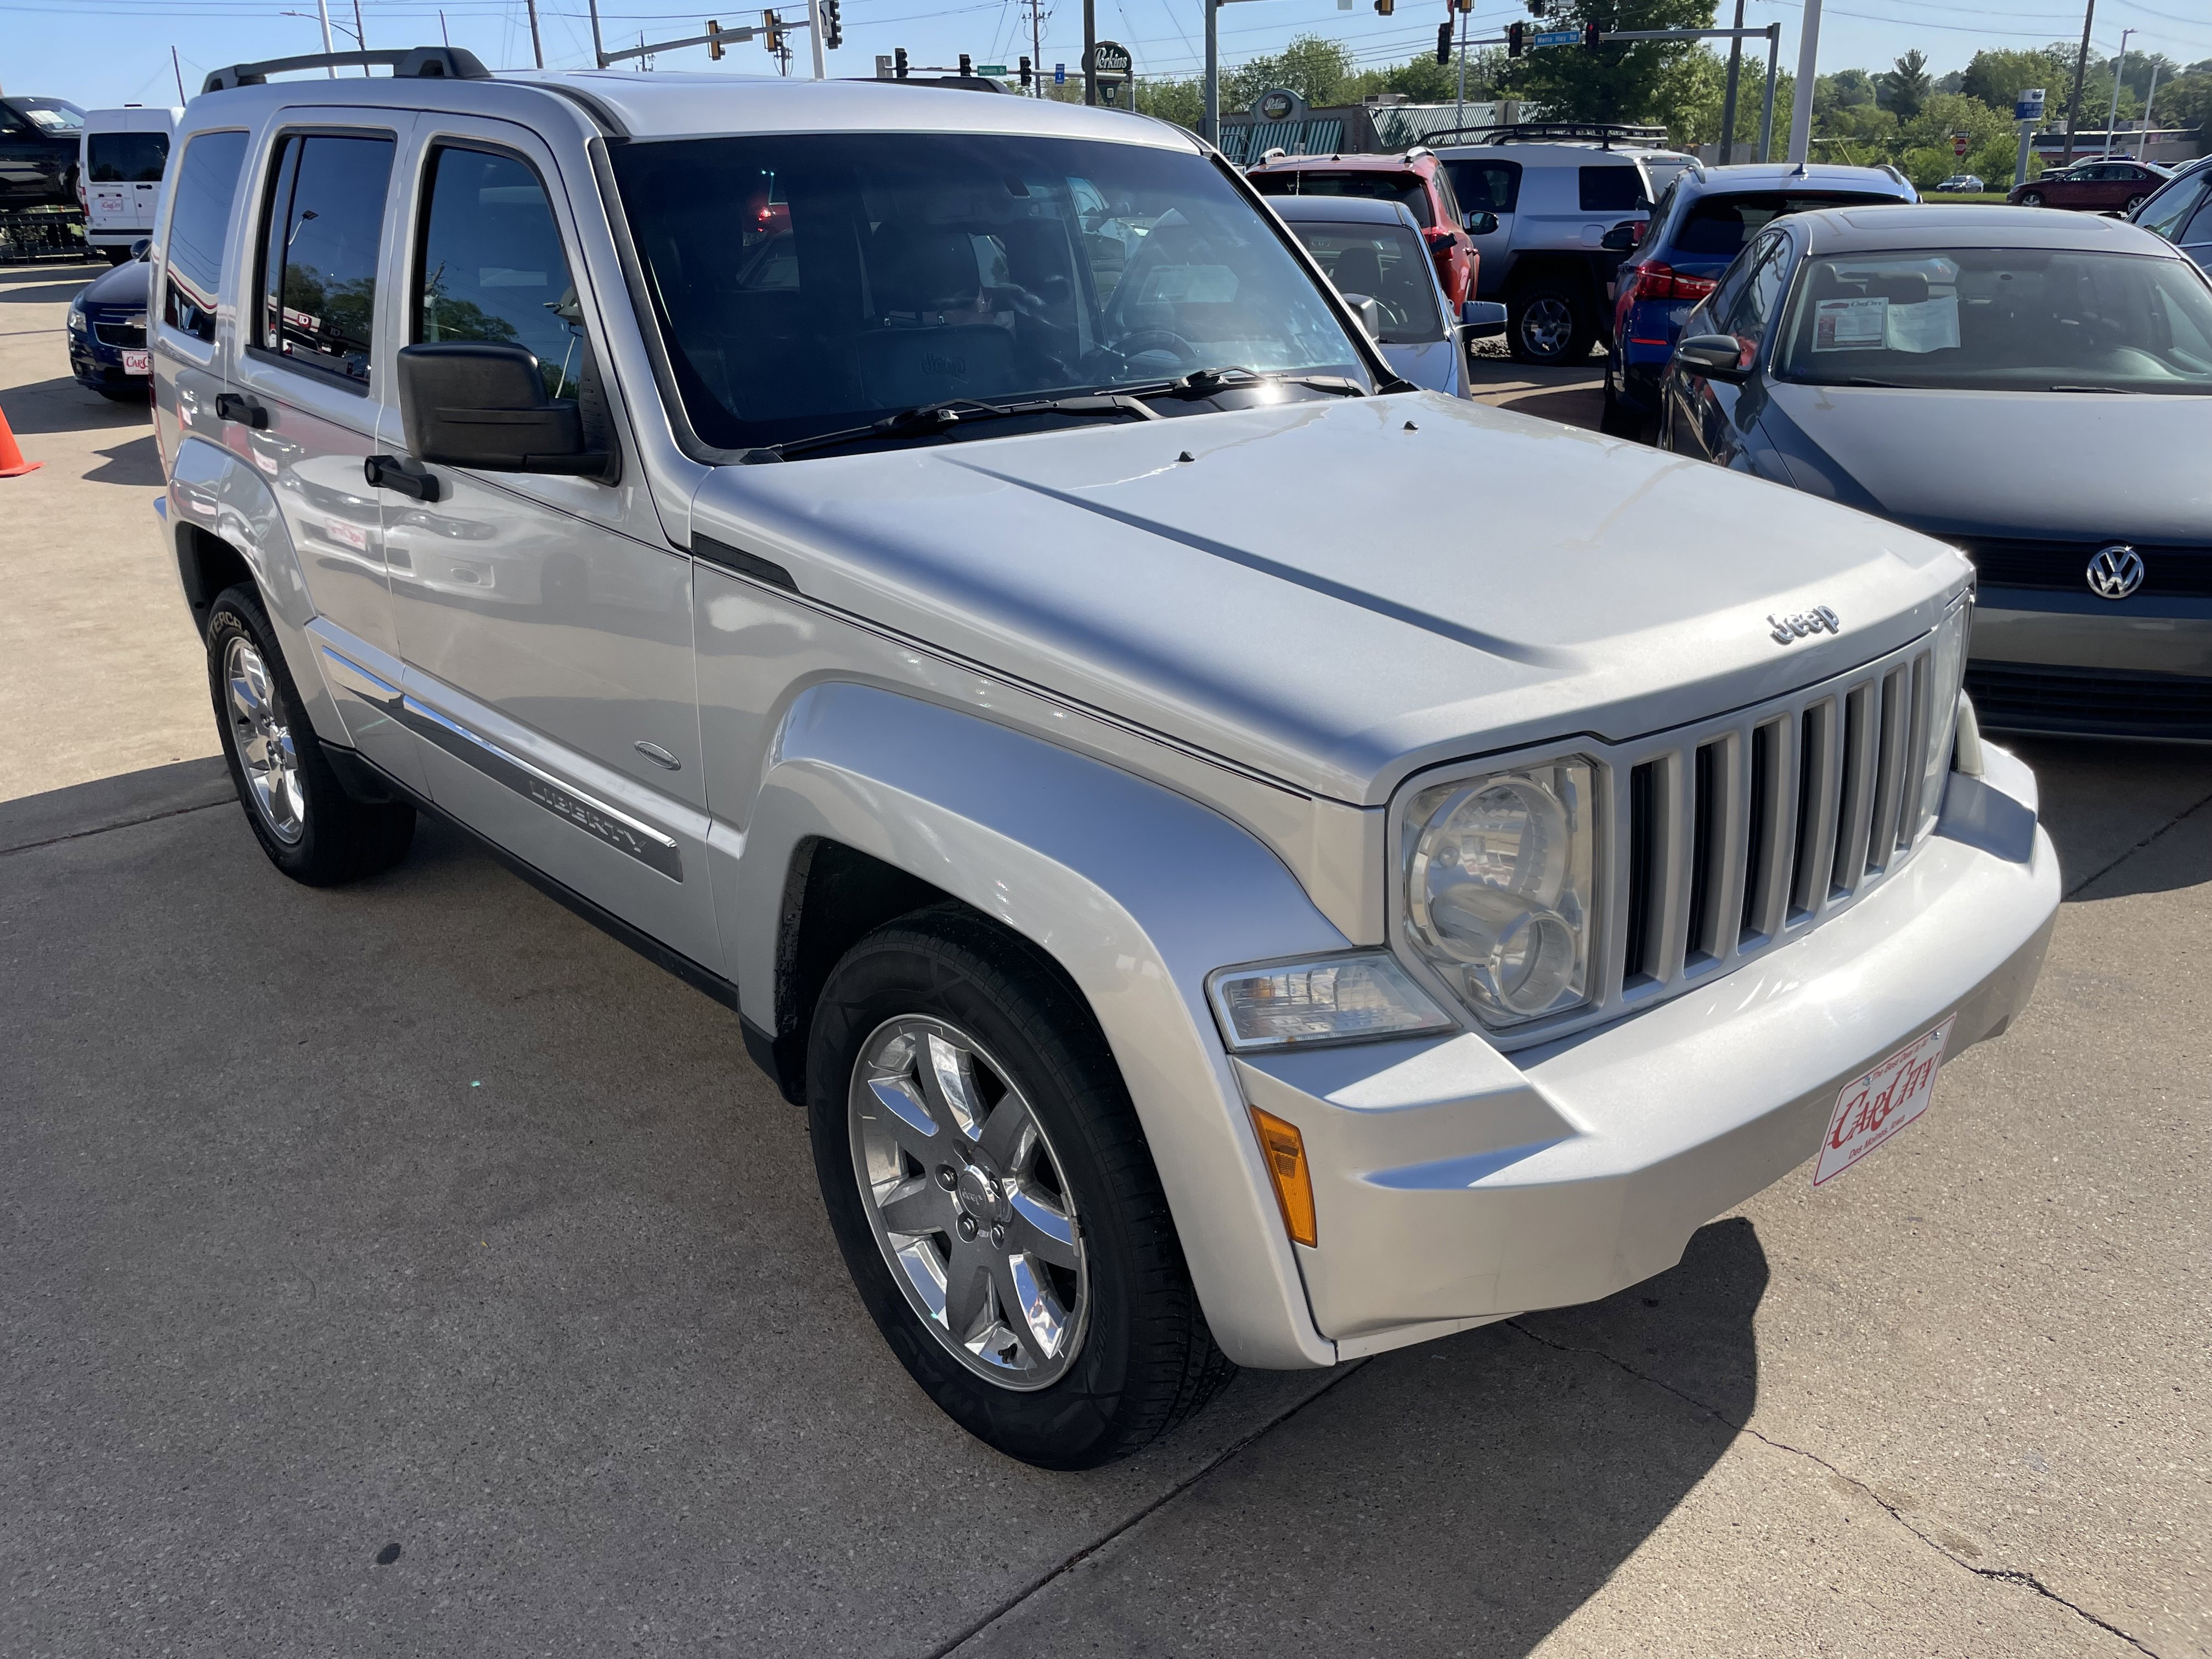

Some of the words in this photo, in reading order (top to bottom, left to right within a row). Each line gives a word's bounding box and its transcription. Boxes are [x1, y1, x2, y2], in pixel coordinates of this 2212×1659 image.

[1095, 47, 1127, 69] Perkins
[920, 352, 964, 375] Jeep
[1767, 606, 1839, 646] Jeep
[529, 780, 647, 853] LIBERTY
[1884, 1058, 1900, 1073] Best
[1900, 1047, 1915, 1063] Deal
[1848, 1145, 1863, 1160] Des
[1889, 1114, 1905, 1131] Iowa
[961, 1187, 983, 1205] Jeep
